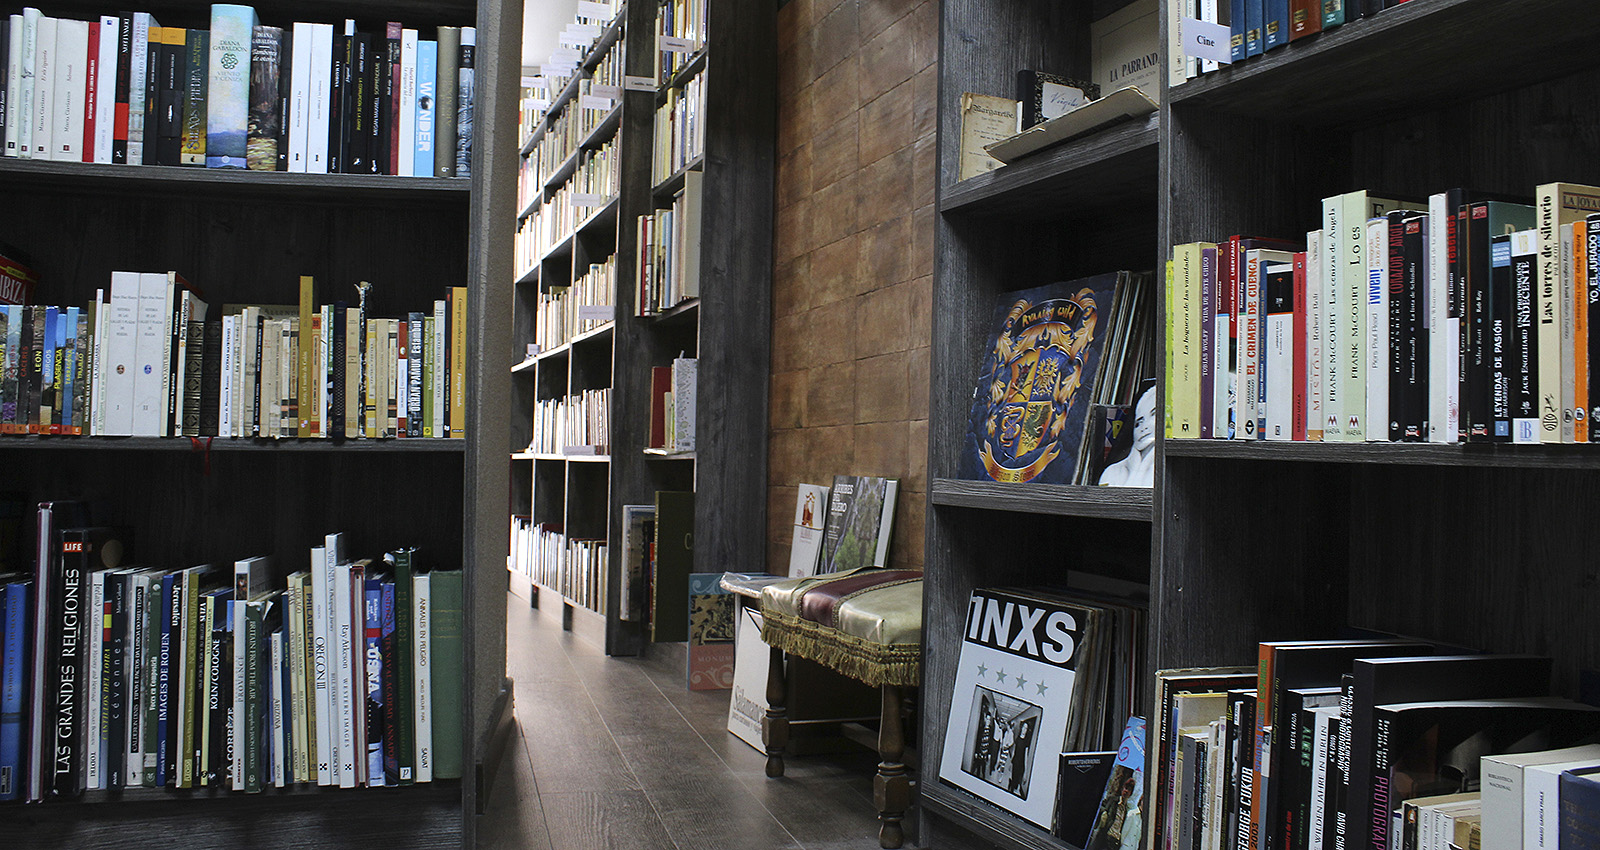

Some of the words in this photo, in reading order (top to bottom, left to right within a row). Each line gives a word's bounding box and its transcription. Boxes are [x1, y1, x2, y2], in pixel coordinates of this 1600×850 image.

[1196, 34, 1216, 47] Cine
[1110, 68, 1118, 82] LA
[1122, 52, 1160, 77] PARRAND
[1326, 207, 1338, 240] Ángela
[1352, 225, 1362, 241] es
[1540, 195, 1553, 241] silencio
[1328, 242, 1337, 253] de
[1541, 244, 1552, 258] de
[1589, 234, 1598, 272] JURADO
[1247, 258, 1258, 297] CUENCA
[1328, 255, 1337, 287] cenizas
[1409, 262, 1417, 290] Schindler
[1541, 261, 1554, 297] torres
[1589, 273, 1598, 285] EL
[1247, 300, 1257, 315] DE
[1328, 289, 1337, 305] Las
[1409, 291, 1416, 299] de
[1476, 289, 1484, 300] Roy
[1521, 261, 1531, 327] INDECENTE
[1590, 288, 1599, 303] YO,
[1350, 284, 1359, 338] McCOURT
[1409, 313, 1416, 322] La
[1541, 300, 1554, 324] Las
[411, 320, 422, 354] Estambul
[1182, 312, 1190, 343] hoguera
[1246, 318, 1256, 358] CRIMEN
[1312, 313, 1320, 341] Robert
[1328, 312, 1337, 364] McCOURT
[1492, 319, 1503, 353] PASIÓN
[44, 349, 52, 378] BURGOS
[54, 348, 63, 390] PLASENCIA
[65, 349, 73, 385] TARRAGONA
[410, 358, 421, 384] PAMUK
[1246, 361, 1256, 375] EL
[1350, 343, 1359, 379] FRANK
[1493, 356, 1503, 368] DE
[1311, 346, 1321, 412] MISIÓN
[1328, 366, 1337, 402] FRANK
[1493, 371, 1503, 417] LEYENDAS
[1502, 376, 1510, 406] HARRISON
[410, 386, 421, 411] ORHAN
[1502, 406, 1510, 418] JIM
[831, 501, 848, 513] DUERO
[64, 543, 83, 552] LIFE
[62, 568, 80, 657] RELIGIONES
[171, 584, 182, 627] Jerusalén
[199, 602, 207, 622] SUIZA
[384, 590, 392, 614] UNITED
[418, 597, 427, 629] ANIMALES
[248, 620, 256, 647] BRITAIN
[305, 593, 315, 658] PHILADELPHIA
[340, 624, 350, 637] Ray
[384, 615, 393, 650] STATES
[419, 630, 427, 639] EN
[968, 595, 1077, 664] INXS
[159, 632, 170, 666] ROUEN
[248, 648, 256, 670] FROM
[315, 636, 326, 680] OREGON
[327, 550, 335, 583] VIRGINIA
[331, 746, 339, 777] CRESCENT
[341, 637, 350, 669] Atkeson
[419, 640, 427, 667] PELIGRO
[159, 667, 169, 681] DE
[209, 638, 220, 709] KÖLN/COLOGNE
[235, 654, 244, 703] PROVENCE
[248, 671, 256, 686] THE
[365, 646, 380, 695] USNA
[385, 652, 393, 679] NAVAL
[316, 680, 326, 690] III
[385, 681, 393, 720] ACADEMY
[58, 664, 76, 738] GRANDES
[159, 682, 168, 721] IMAGES
[273, 698, 281, 730] ARIZONA
[102, 694, 110, 740] CASTILLOS
[386, 723, 394, 768] ANNAPOLIS
[420, 747, 428, 769] SALVAT
[1254, 735, 1263, 773] SPANISH
[1301, 725, 1310, 767] ALIENS
[1318, 725, 1327, 760] BERLIN
[1337, 717, 1347, 771] PHOTOGRAPHY
[56, 745, 71, 774] LAS
[1317, 760, 1326, 772] IN
[1239, 766, 1253, 806] CUKOR
[1315, 774, 1325, 803] JAHRE
[1489, 781, 1512, 792] NACIONAL
[1251, 822, 1259, 848] 2003
[1314, 803, 1323, 844] WILDEN
[1336, 812, 1346, 834] DAVID
